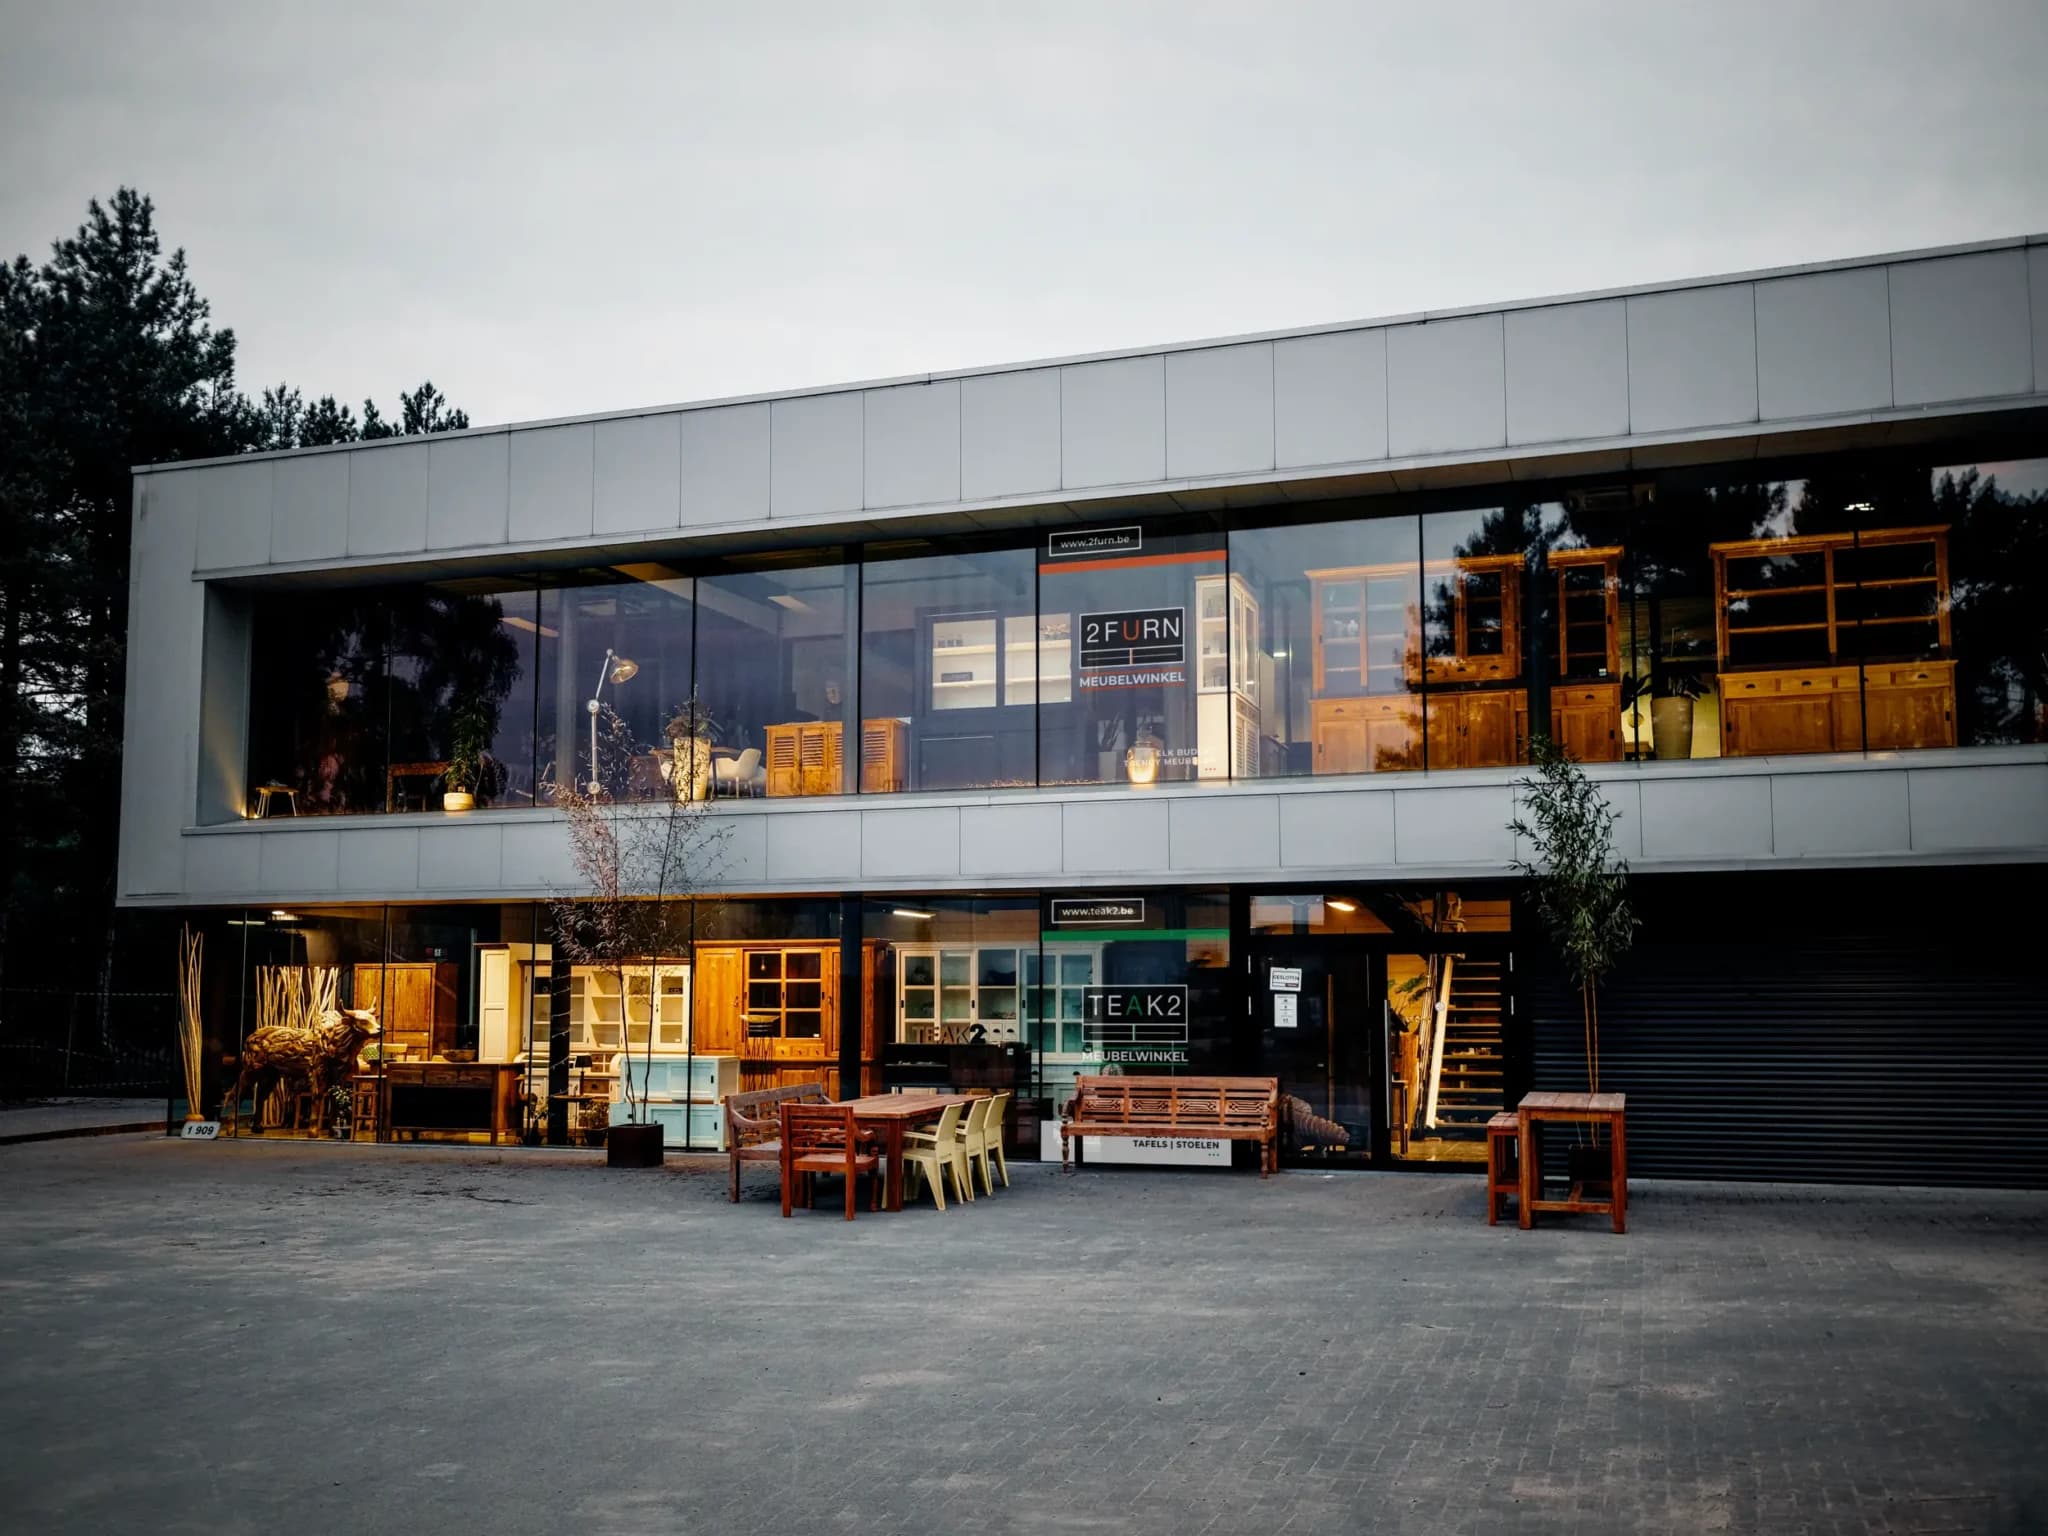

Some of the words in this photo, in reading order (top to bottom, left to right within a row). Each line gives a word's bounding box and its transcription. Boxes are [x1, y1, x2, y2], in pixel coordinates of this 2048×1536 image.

[1061, 536, 1130, 548] www.2furn.be
[1086, 617, 1180, 643] 2FURN
[1080, 672, 1184, 688] MEUBELWINKEL
[1062, 906, 1134, 916] www.teak2.be
[1088, 995, 1180, 1016] TEAK2
[1082, 1051, 1188, 1062] MEUBELWINKEL
[1133, 1140, 1168, 1149] TAFELS
[1176, 1141, 1219, 1150] STOELEN
